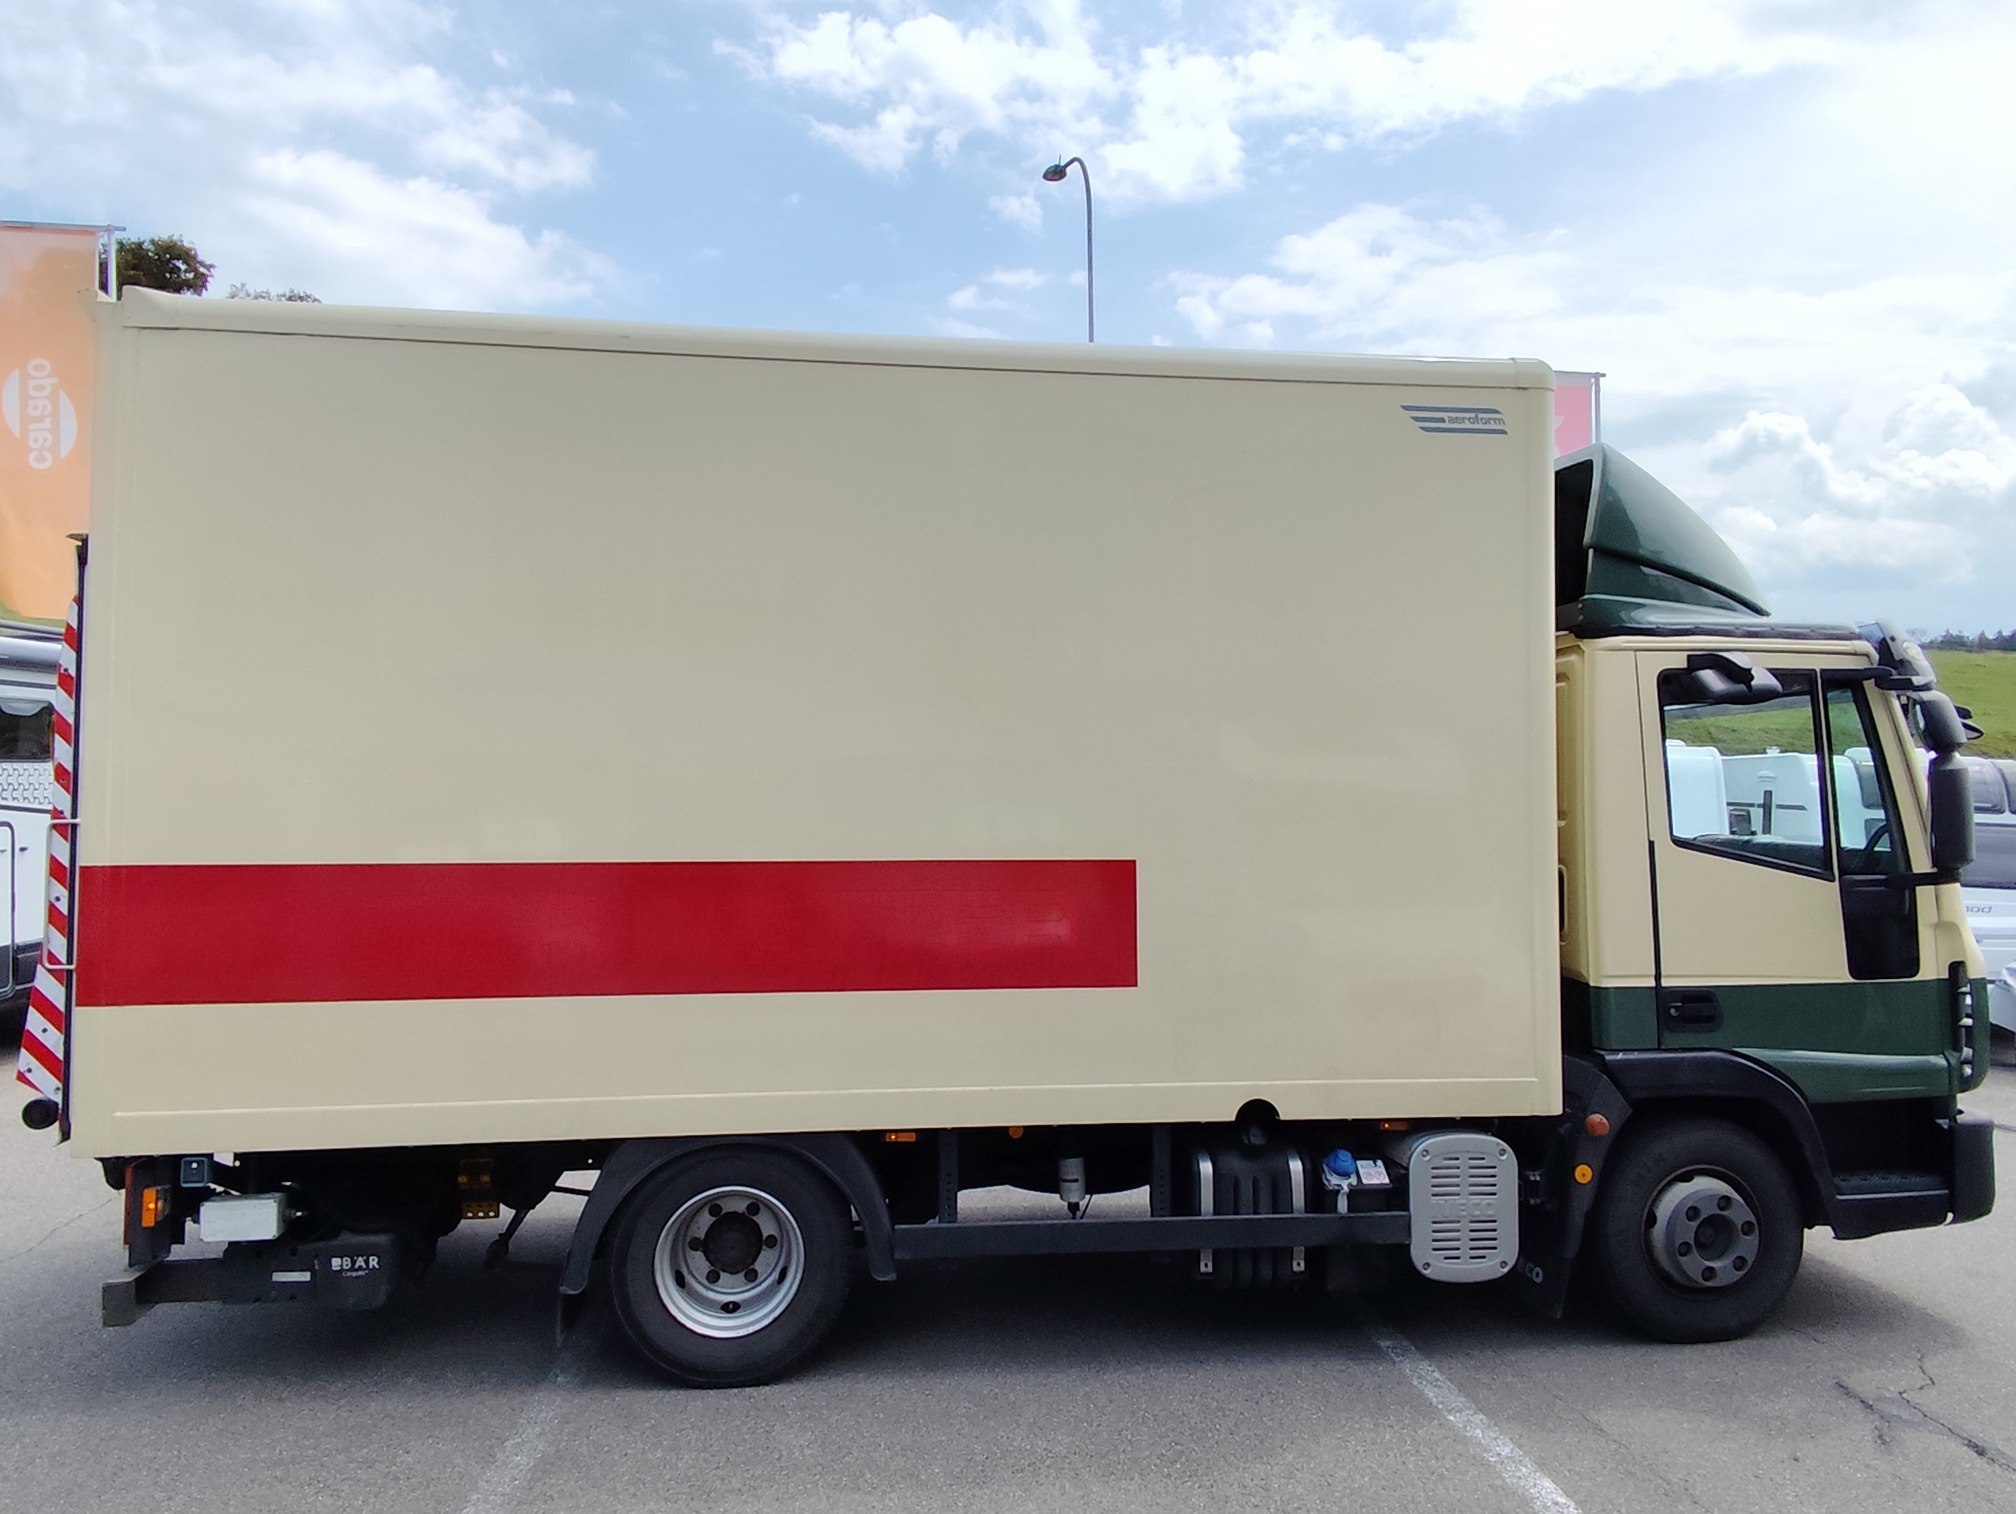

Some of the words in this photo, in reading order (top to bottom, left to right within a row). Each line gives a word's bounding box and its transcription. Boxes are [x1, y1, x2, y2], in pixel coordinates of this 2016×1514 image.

[1447, 413, 1506, 426] aeroform
[1430, 1200, 1498, 1219] IVECO
[342, 1255, 380, 1270] BÄR
